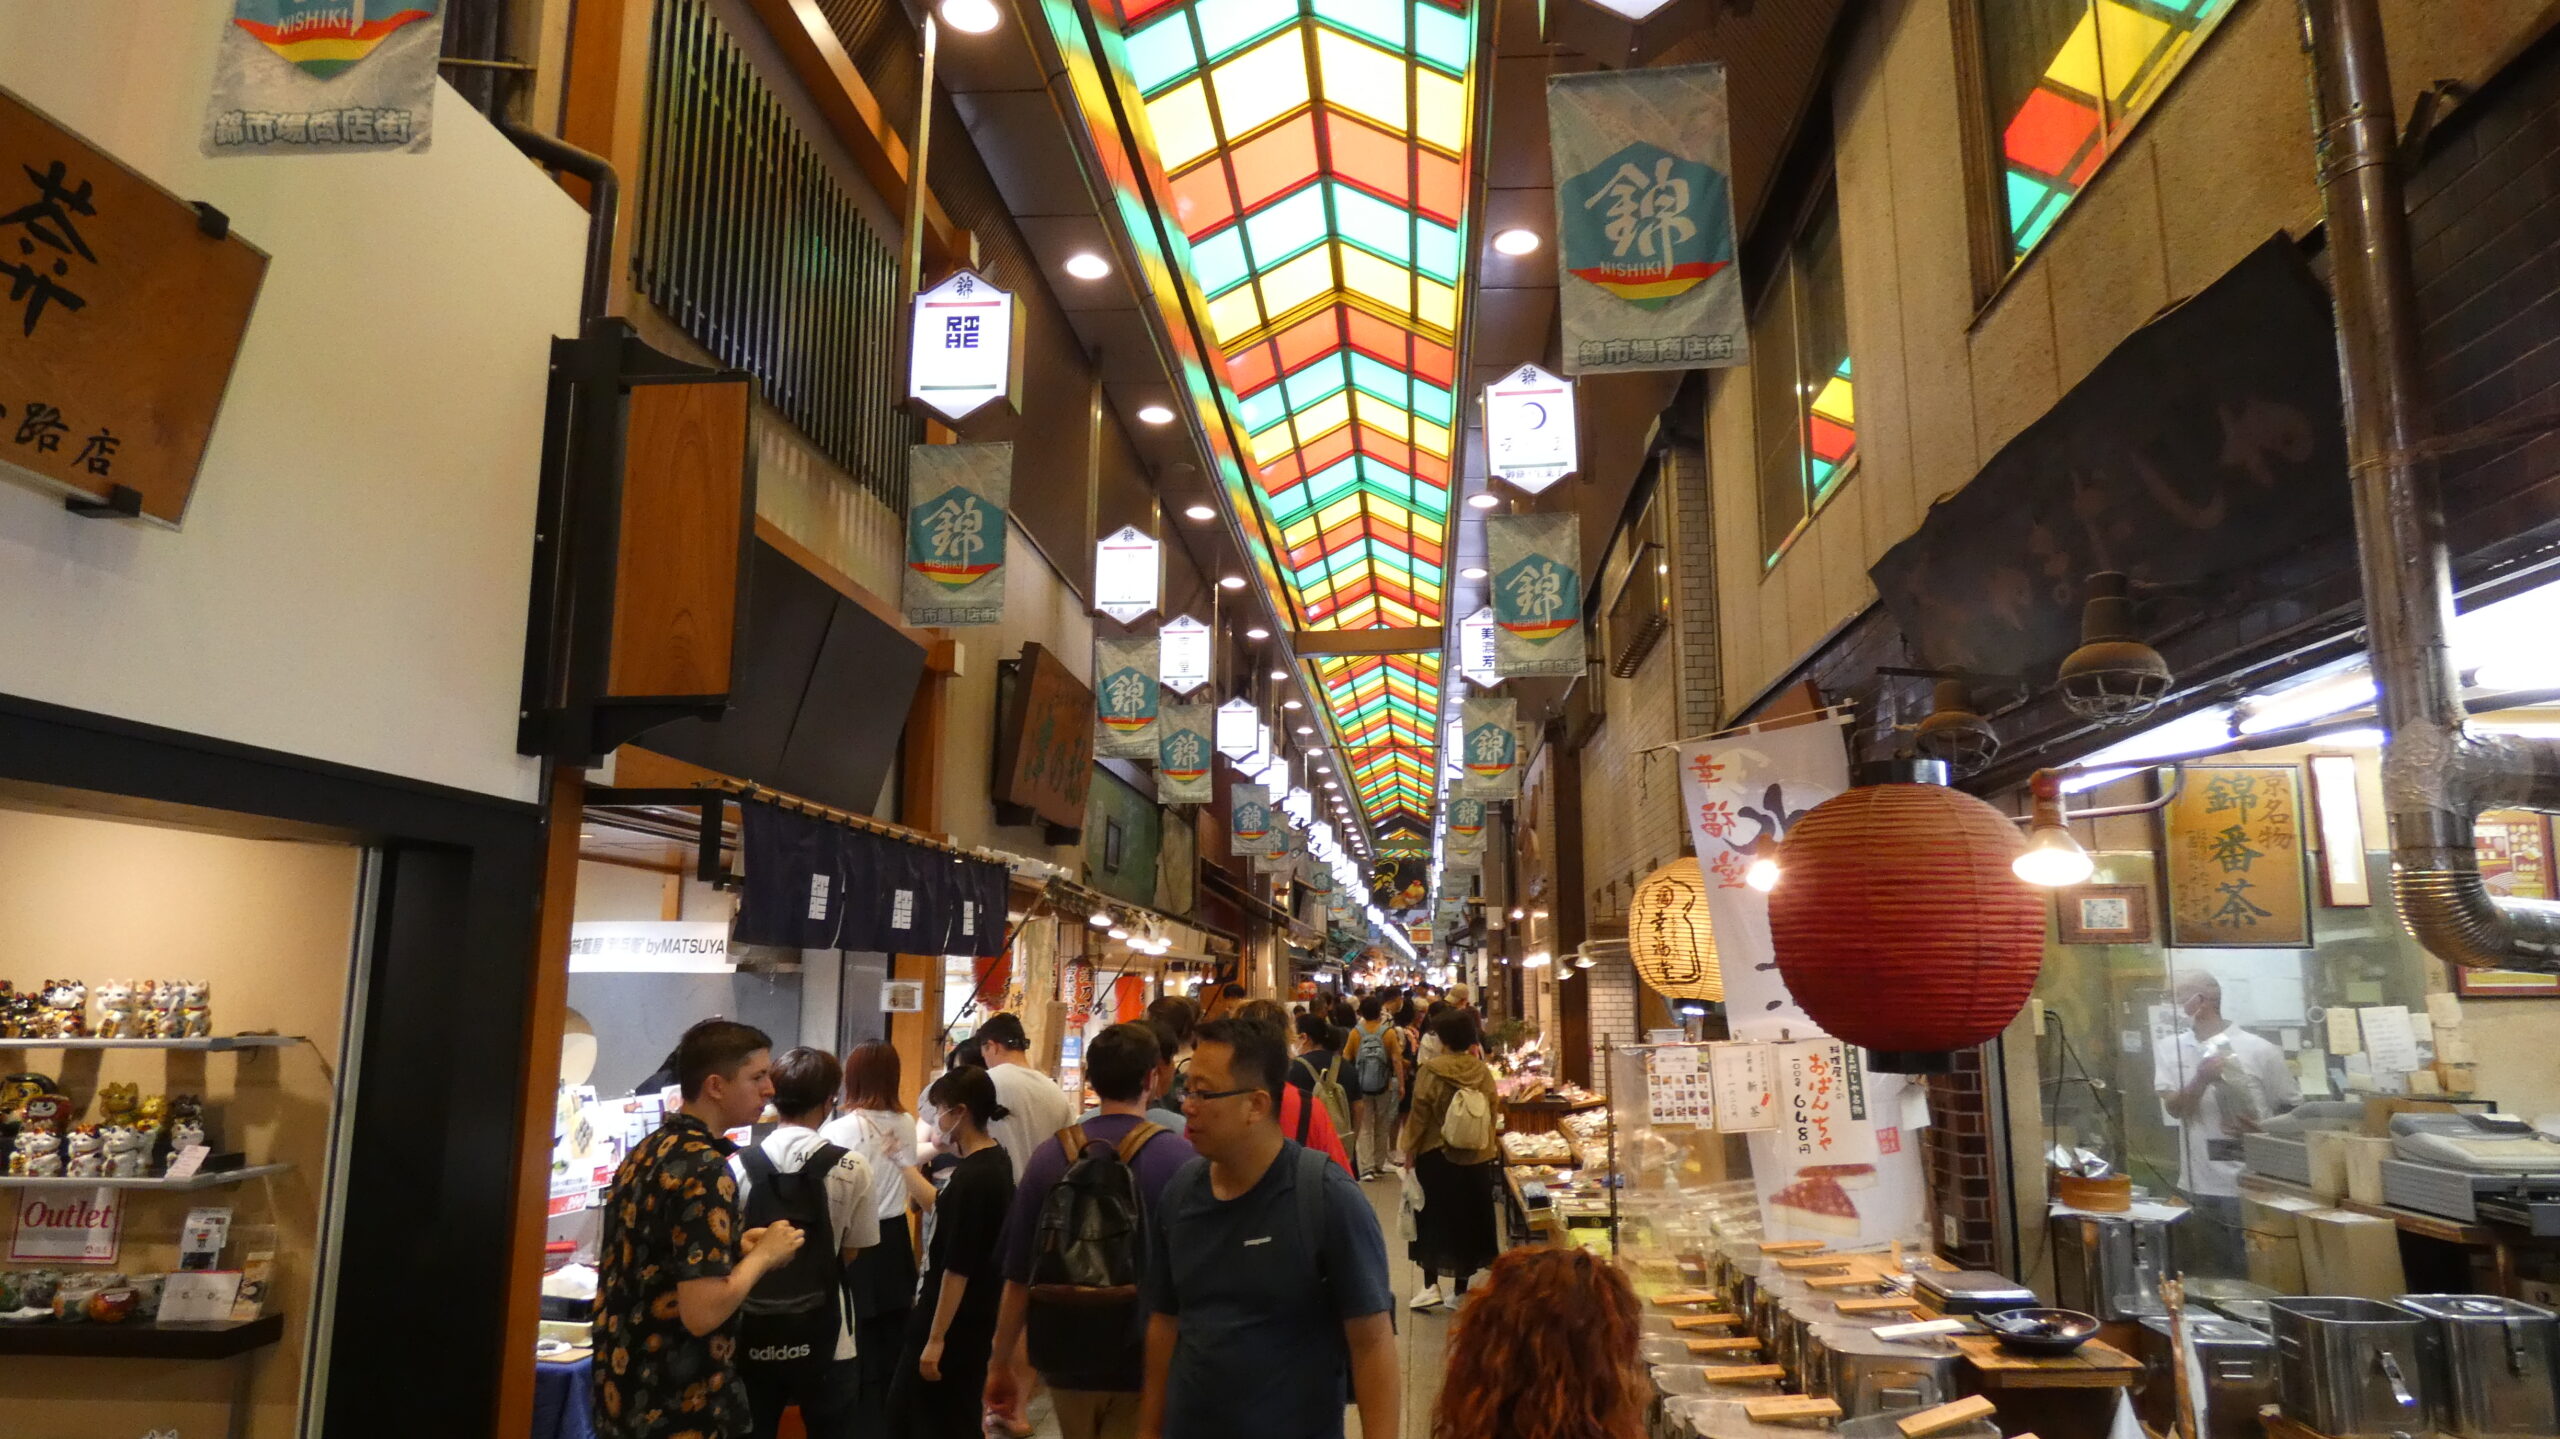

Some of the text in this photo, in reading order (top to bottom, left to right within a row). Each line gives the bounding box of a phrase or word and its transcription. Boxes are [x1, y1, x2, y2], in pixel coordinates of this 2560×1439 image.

[277, 9, 348, 35] NISHIKI
[214, 107, 411, 147] 錦市場商店街
[1585, 157, 1697, 279] 錦
[0, 160, 97, 337] 茶
[1600, 260, 1664, 275] NISHIKI
[953, 275, 973, 299] 錦
[1579, 334, 1734, 365] 錦市場商店街
[0, 401, 121, 477] 路店
[921, 496, 985, 574] 錦
[1505, 562, 1563, 628] 錦
[1106, 672, 1145, 723] 錦
[1167, 732, 1200, 774] 錦
[1470, 727, 1504, 768] 錦
[2258, 770, 2296, 850] 京名物
[2201, 773, 2273, 929] 錦番茶
[24, 1201, 112, 1228] Outlet
[749, 1344, 811, 1361] adidas
